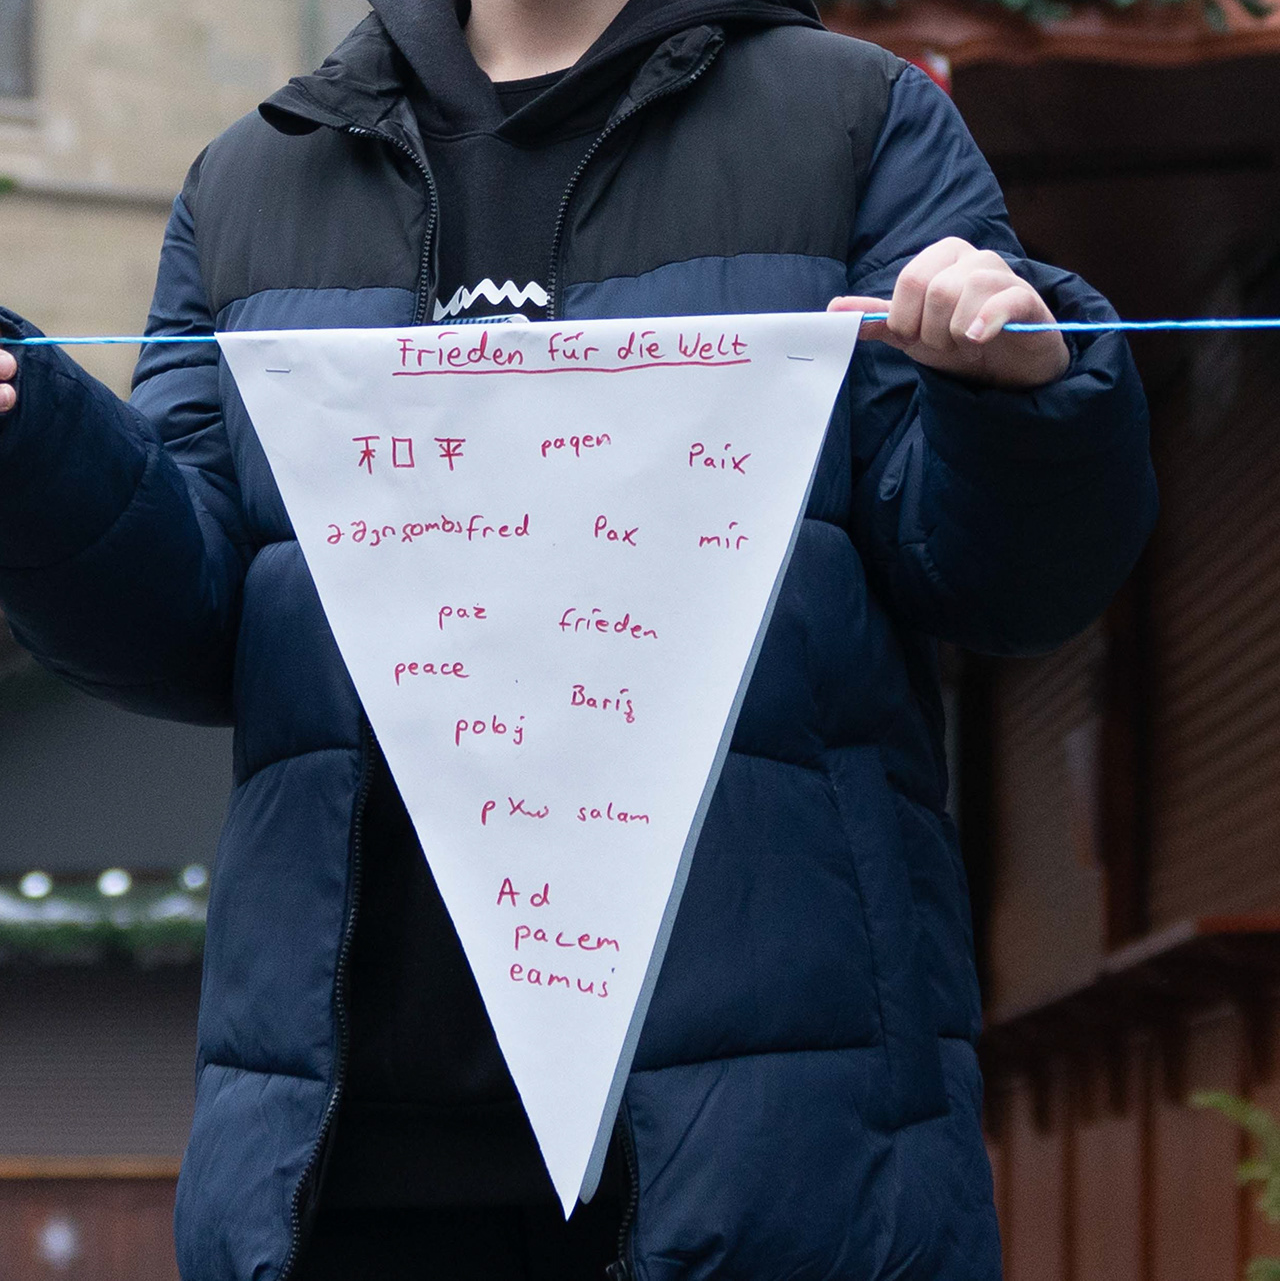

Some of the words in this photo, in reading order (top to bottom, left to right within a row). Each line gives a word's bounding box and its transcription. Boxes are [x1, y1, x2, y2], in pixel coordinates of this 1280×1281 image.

[396, 330, 524, 367] Frieden
[548, 331, 600, 362] für
[617, 330, 666, 360] die
[678, 332, 748, 360] Welt
[688, 441, 750, 474] Paix
[593, 514, 638, 547] Pax
[698, 520, 748, 550] mir
[394, 661, 469, 685] peace
[577, 802, 650, 825] salam
[496, 877, 550, 907] Ad
[514, 924, 620, 952] pacem
